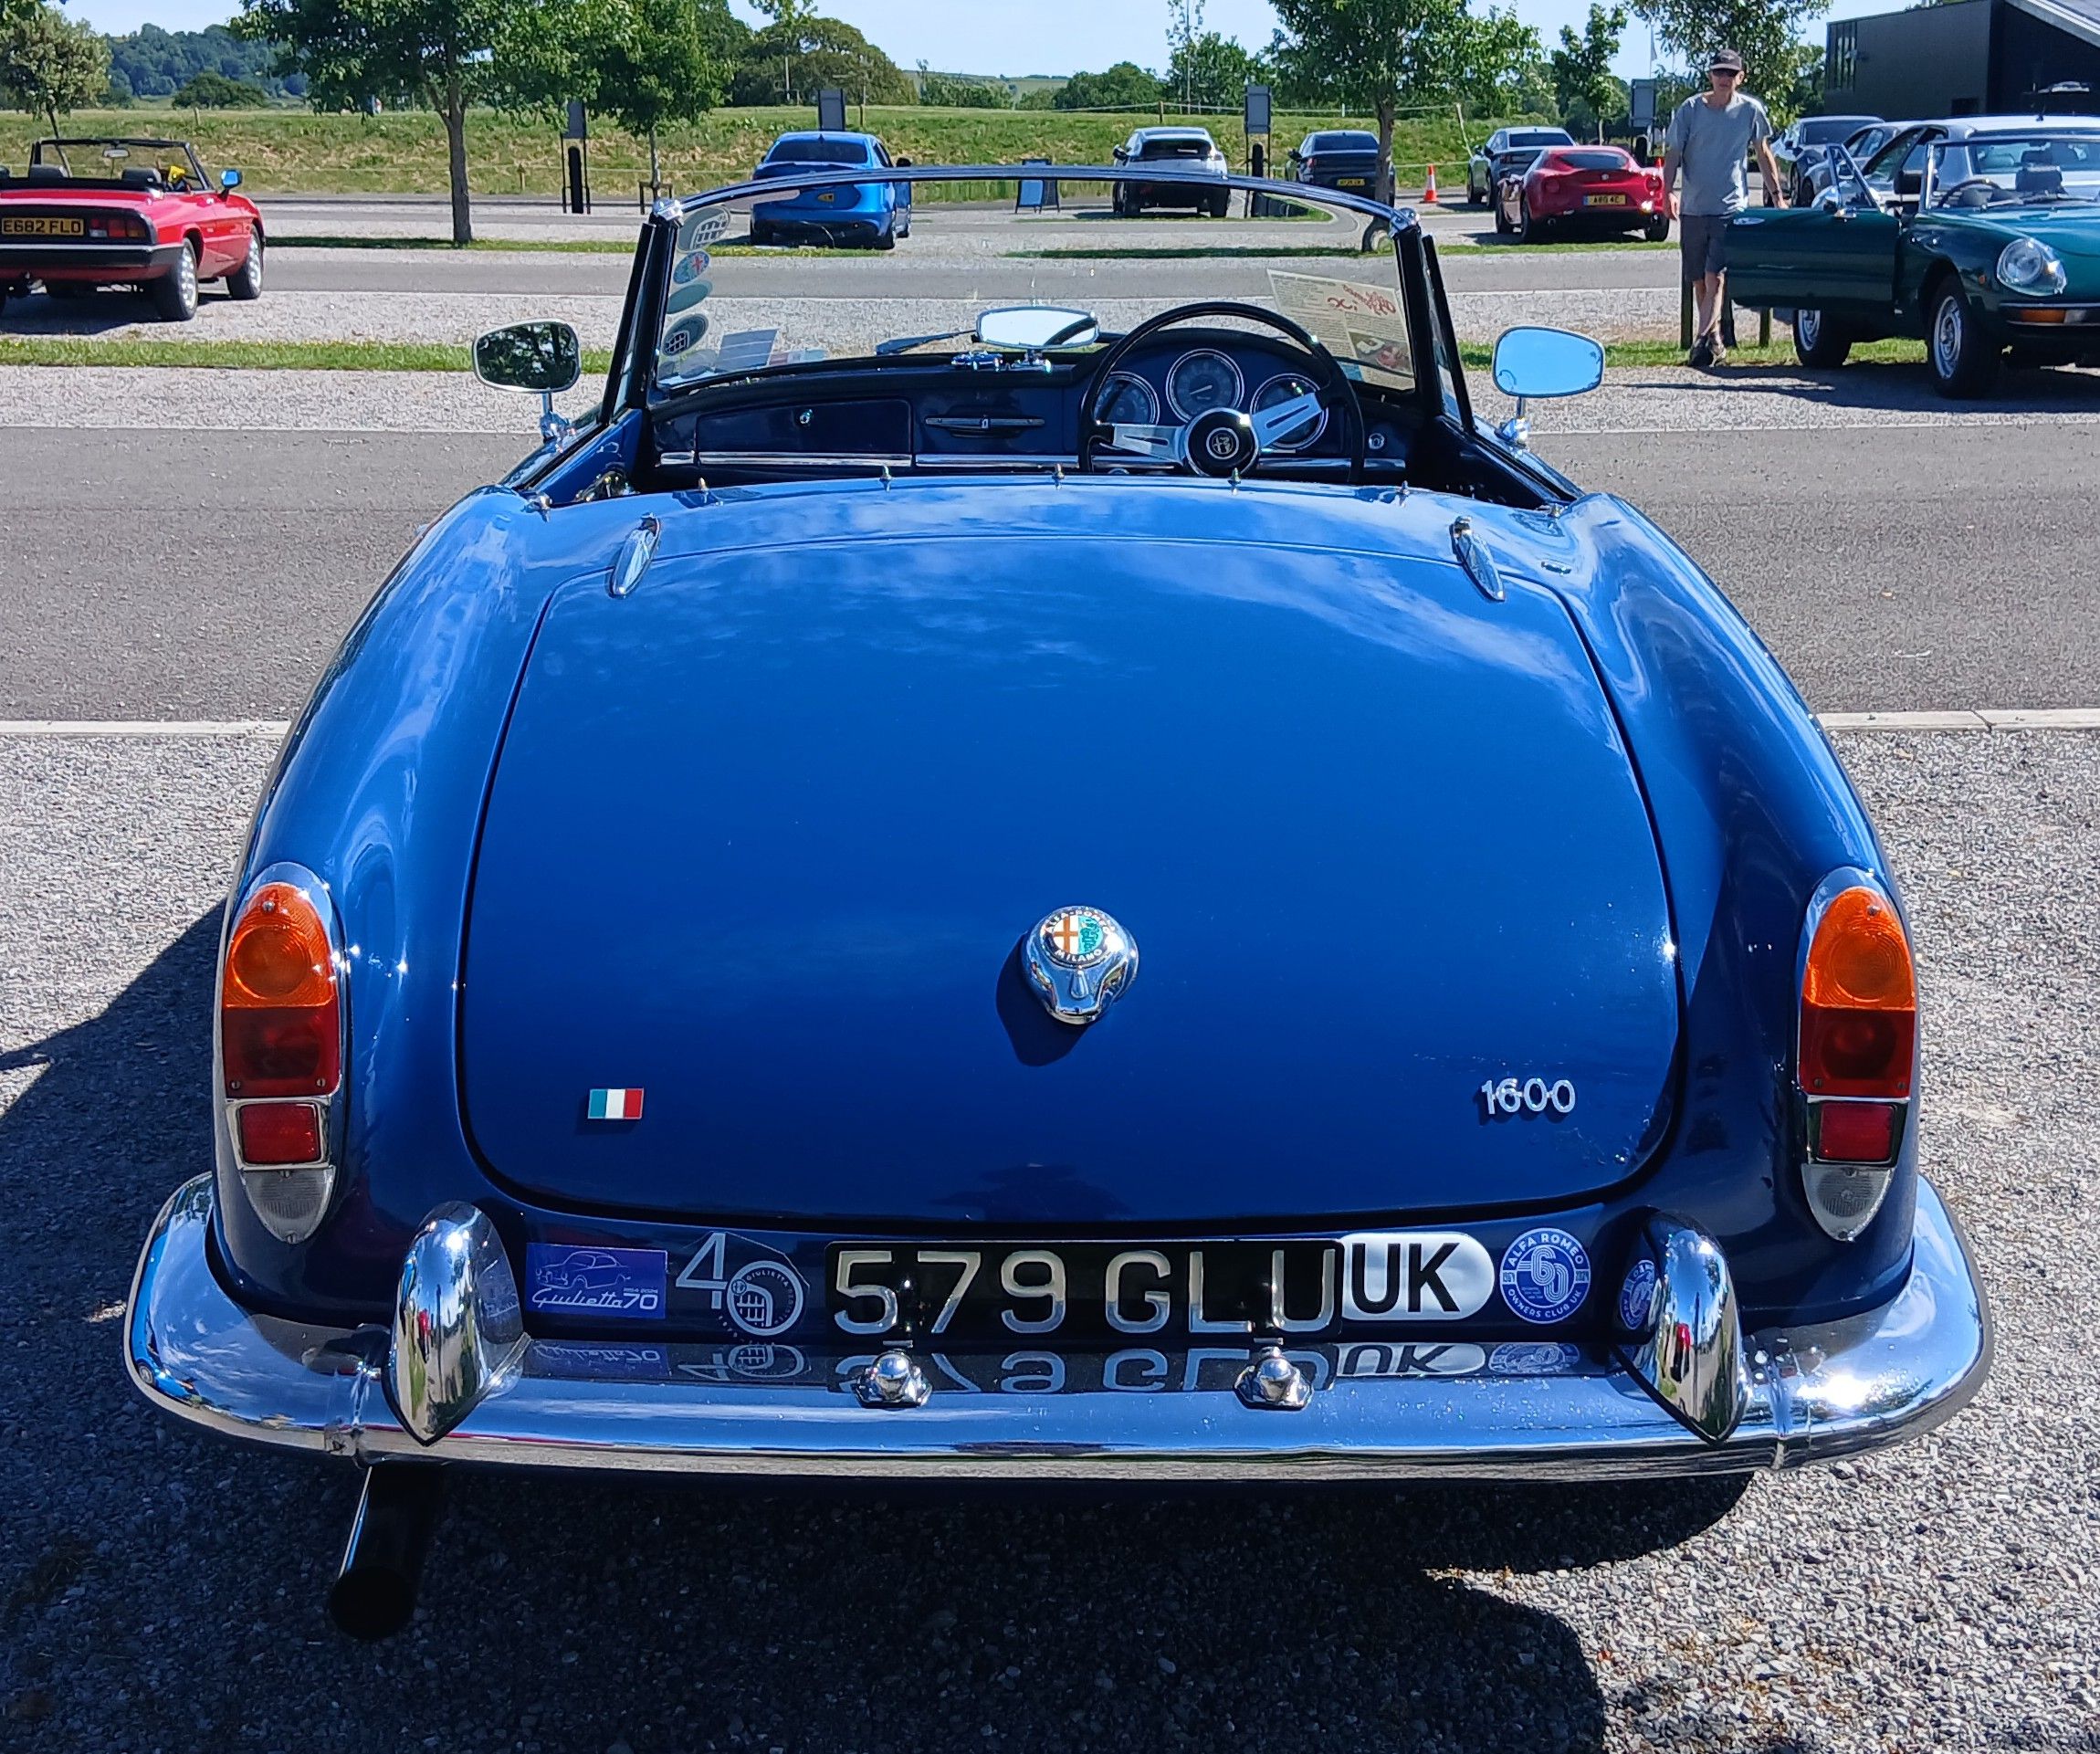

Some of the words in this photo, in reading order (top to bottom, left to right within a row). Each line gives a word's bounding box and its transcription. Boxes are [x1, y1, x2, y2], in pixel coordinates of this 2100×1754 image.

[4, 220, 45, 233] E682
[1055, 949, 1103, 962] MILANO
[1481, 1077, 1576, 1115] 1600
[1507, 1236, 1538, 1267] ALFA
[1540, 1233, 1584, 1265] ROMEO
[834, 1249, 1066, 1334] 579
[1105, 1248, 1336, 1333] GLU
[1351, 1243, 1460, 1314] UK
[531, 1287, 623, 1308] Giulietta
[623, 1292, 658, 1310] 70
[1507, 1288, 1542, 1318] OWNERS
[1544, 1303, 1570, 1318] CLUB
[1570, 1289, 1582, 1304] UK
